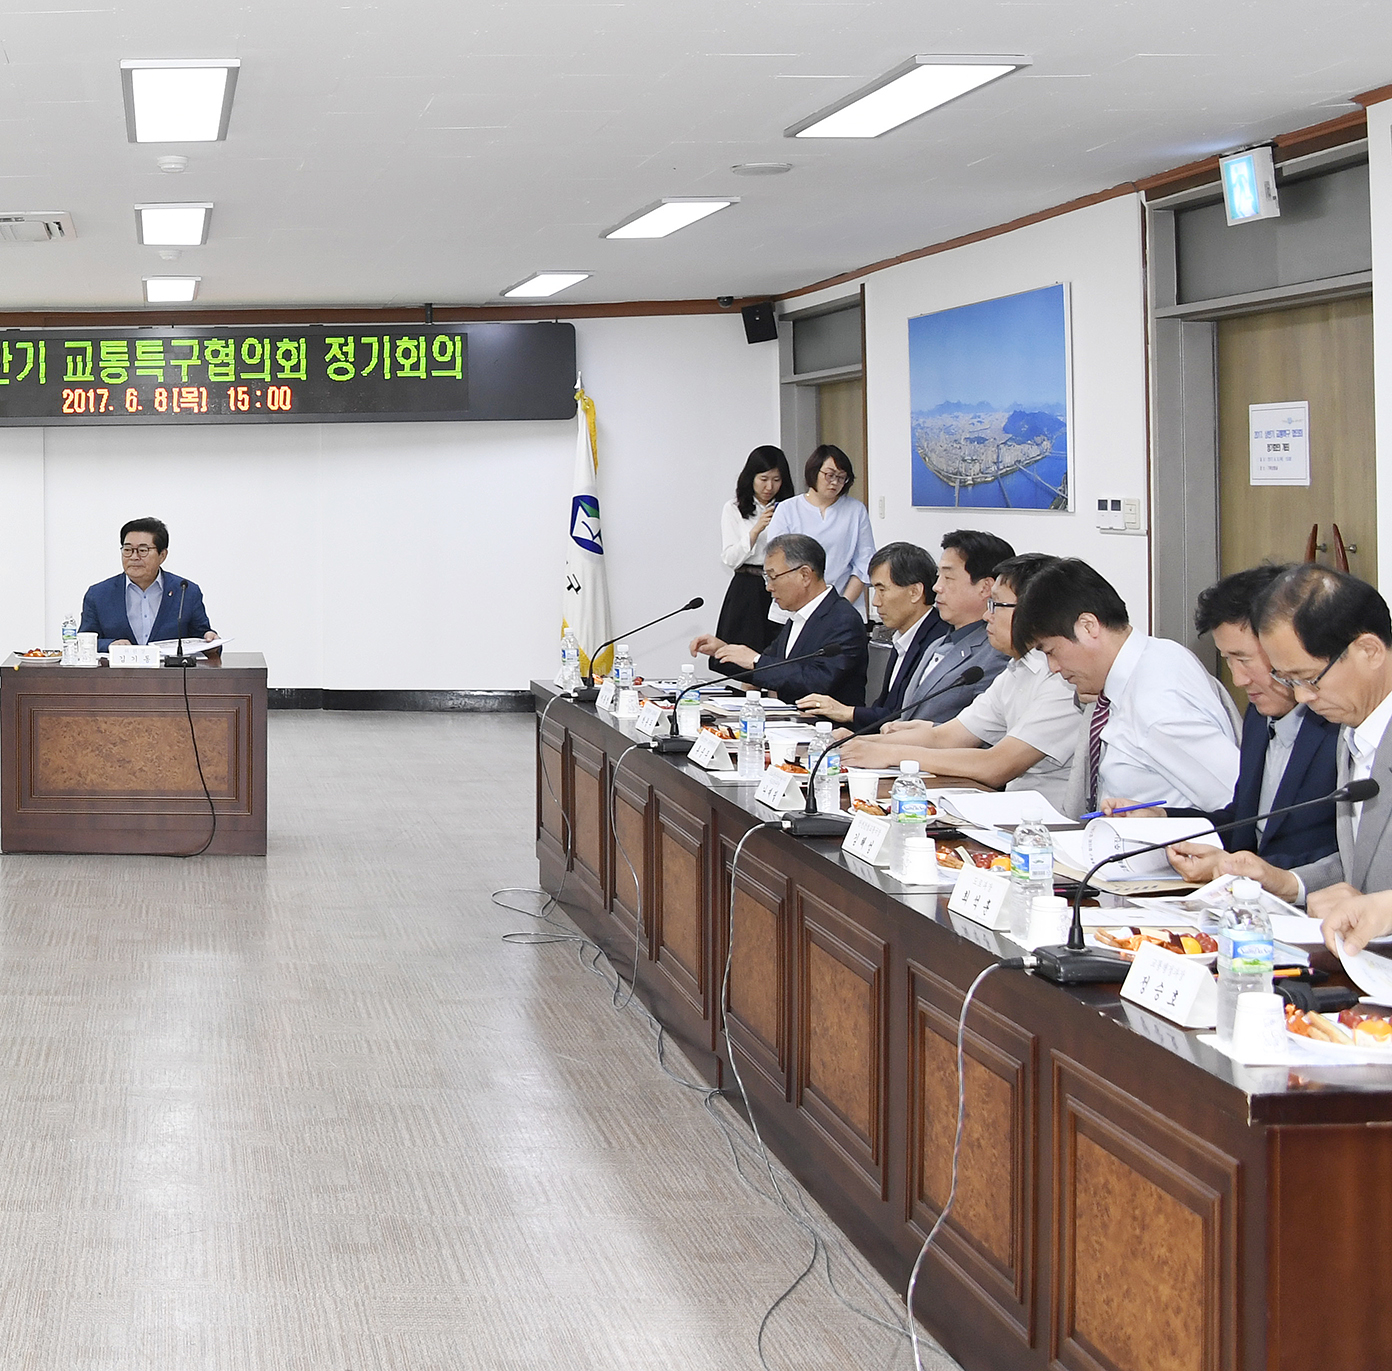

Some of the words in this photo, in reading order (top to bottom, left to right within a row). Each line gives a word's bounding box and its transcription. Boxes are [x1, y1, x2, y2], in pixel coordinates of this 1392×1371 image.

[63, 337, 307, 385] 교통특구협의회
[324, 334, 463, 381] 정기회의
[62, 388, 114, 413] 2017.
[125, 387, 143, 413] 6.
